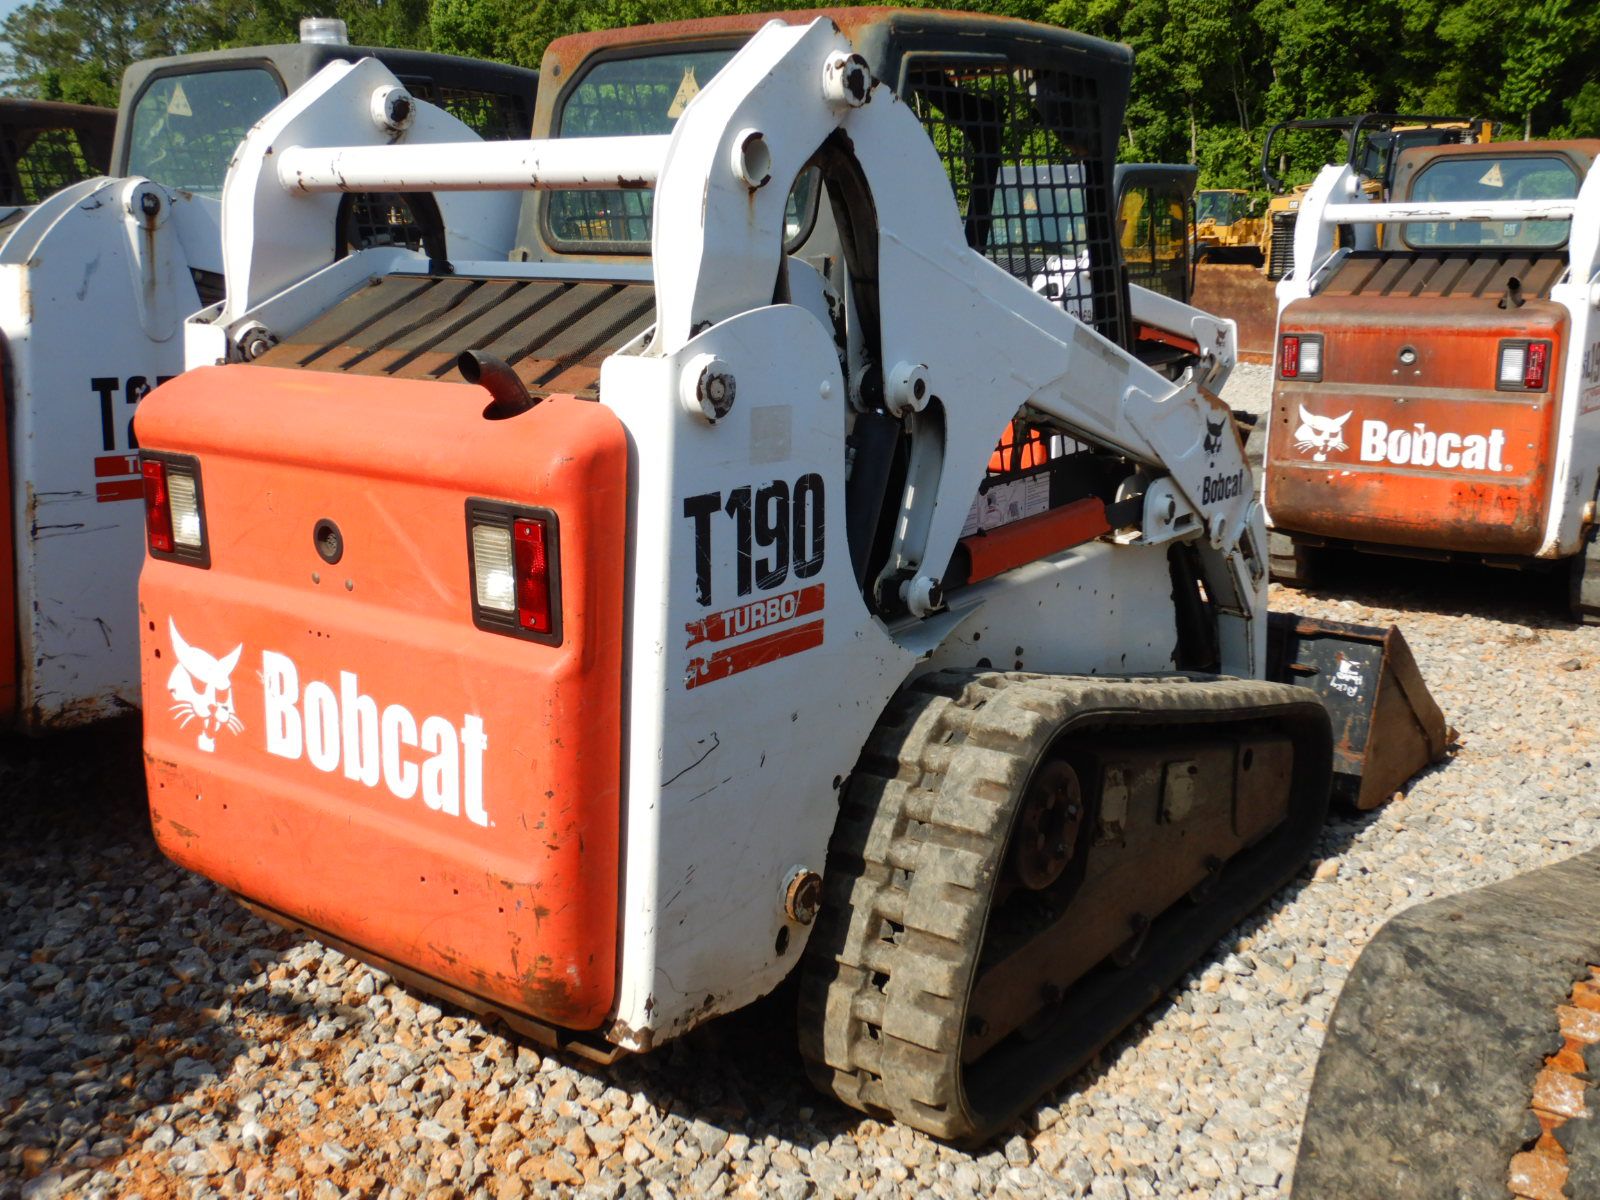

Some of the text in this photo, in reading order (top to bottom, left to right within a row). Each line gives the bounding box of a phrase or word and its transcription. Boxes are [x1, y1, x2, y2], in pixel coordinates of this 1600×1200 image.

[1360, 420, 1505, 472] Bobcat
[1202, 468, 1243, 506] Bobcat
[683, 472, 825, 607] T190
[720, 592, 797, 638] TURBO
[262, 649, 488, 828] Bobcat
